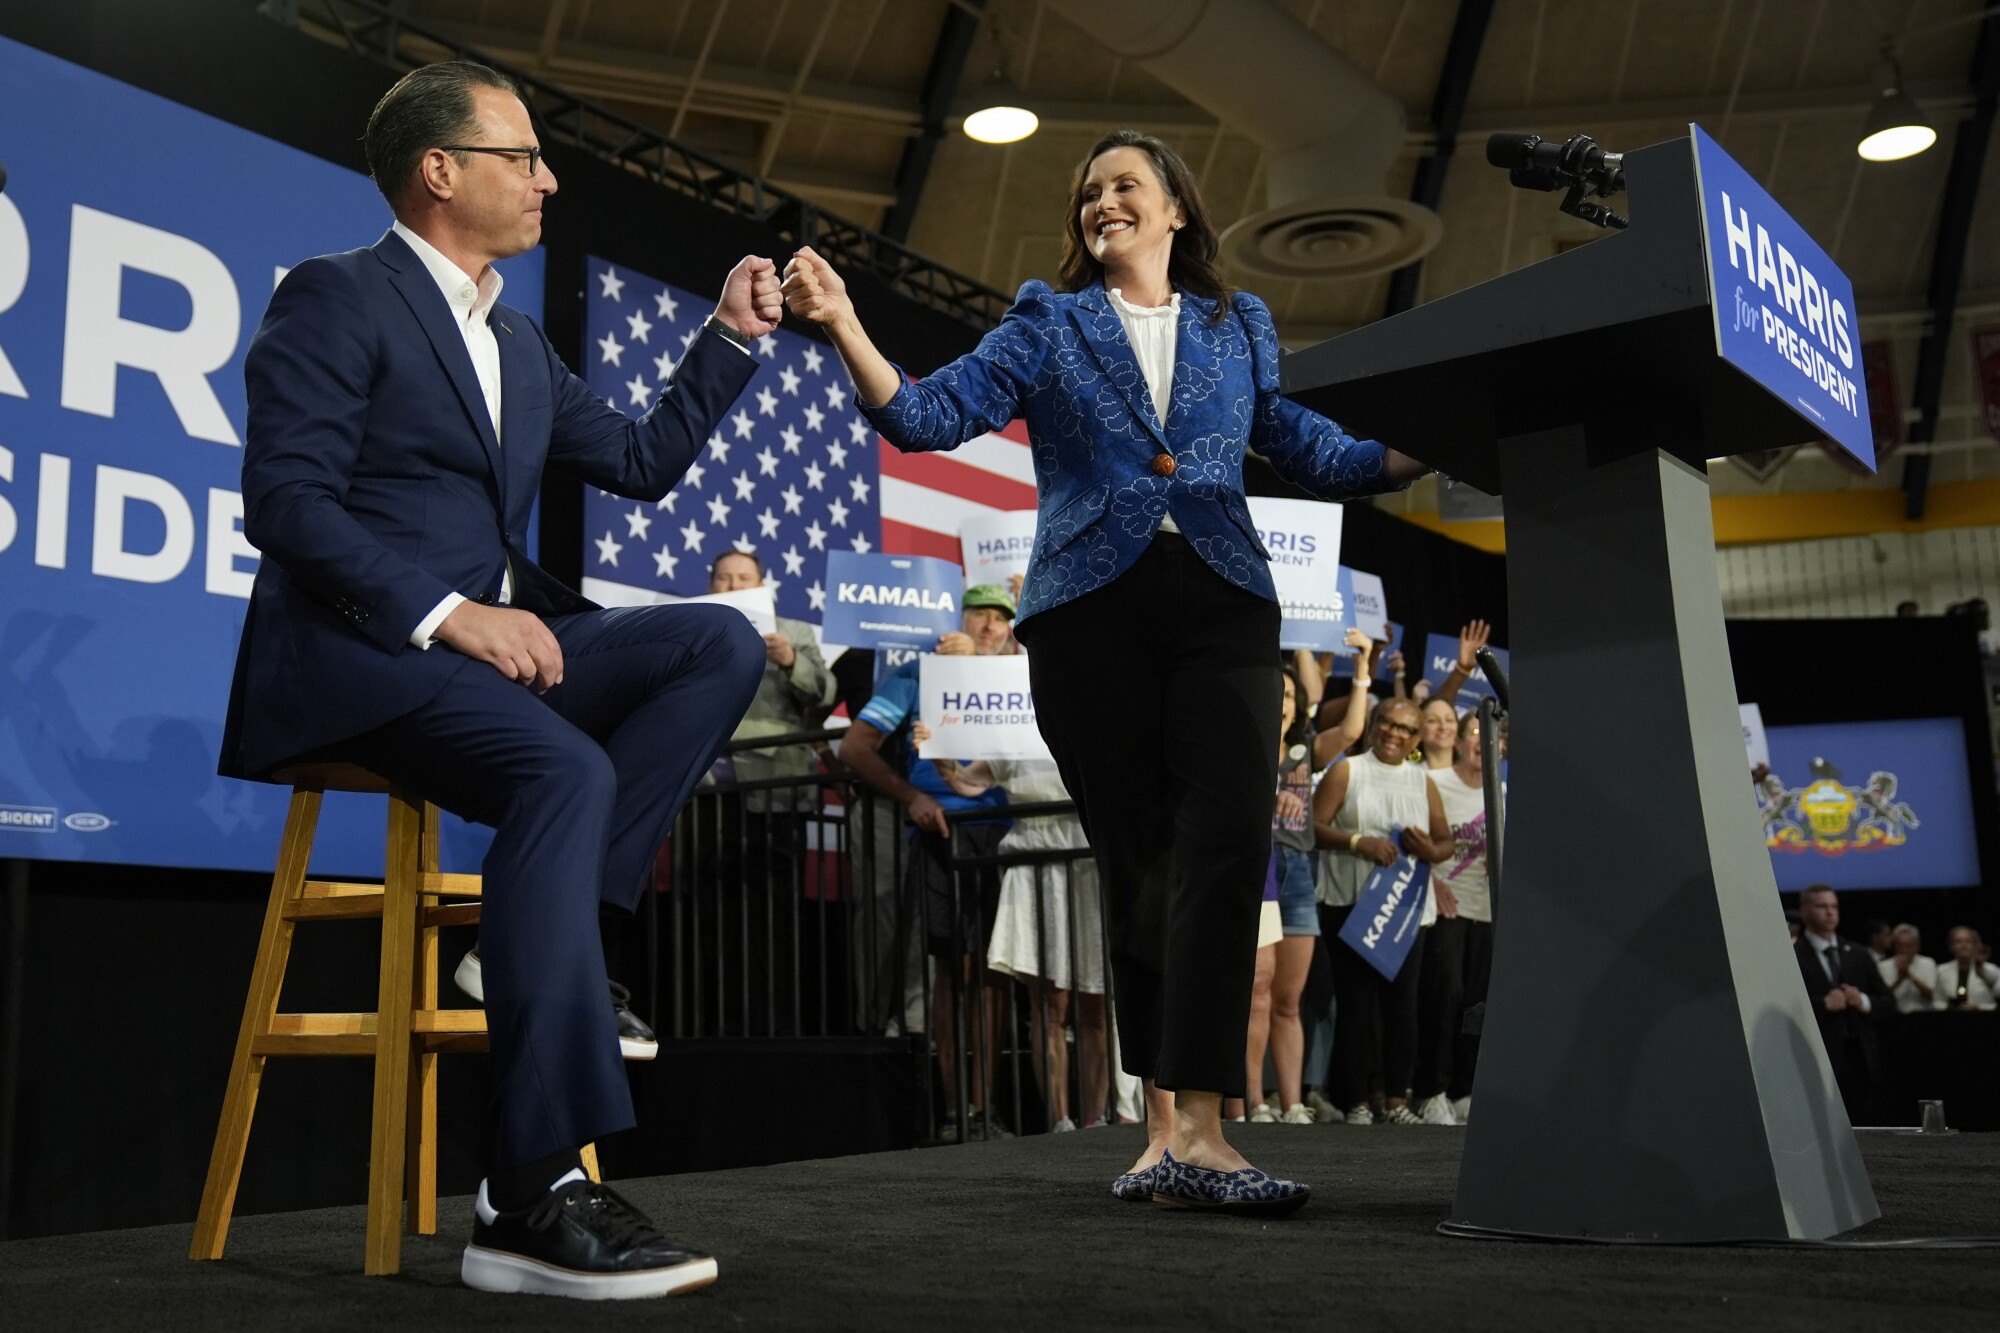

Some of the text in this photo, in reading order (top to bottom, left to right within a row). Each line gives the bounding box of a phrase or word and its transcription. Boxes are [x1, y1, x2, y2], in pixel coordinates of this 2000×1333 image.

[1721, 191, 1854, 370] HARRIS
[1733, 285, 1858, 418] for PRESIDENT
[837, 582, 955, 612] KAMALA
[1280, 607, 1344, 622] ESIDENT
[940, 712, 961, 727] for
